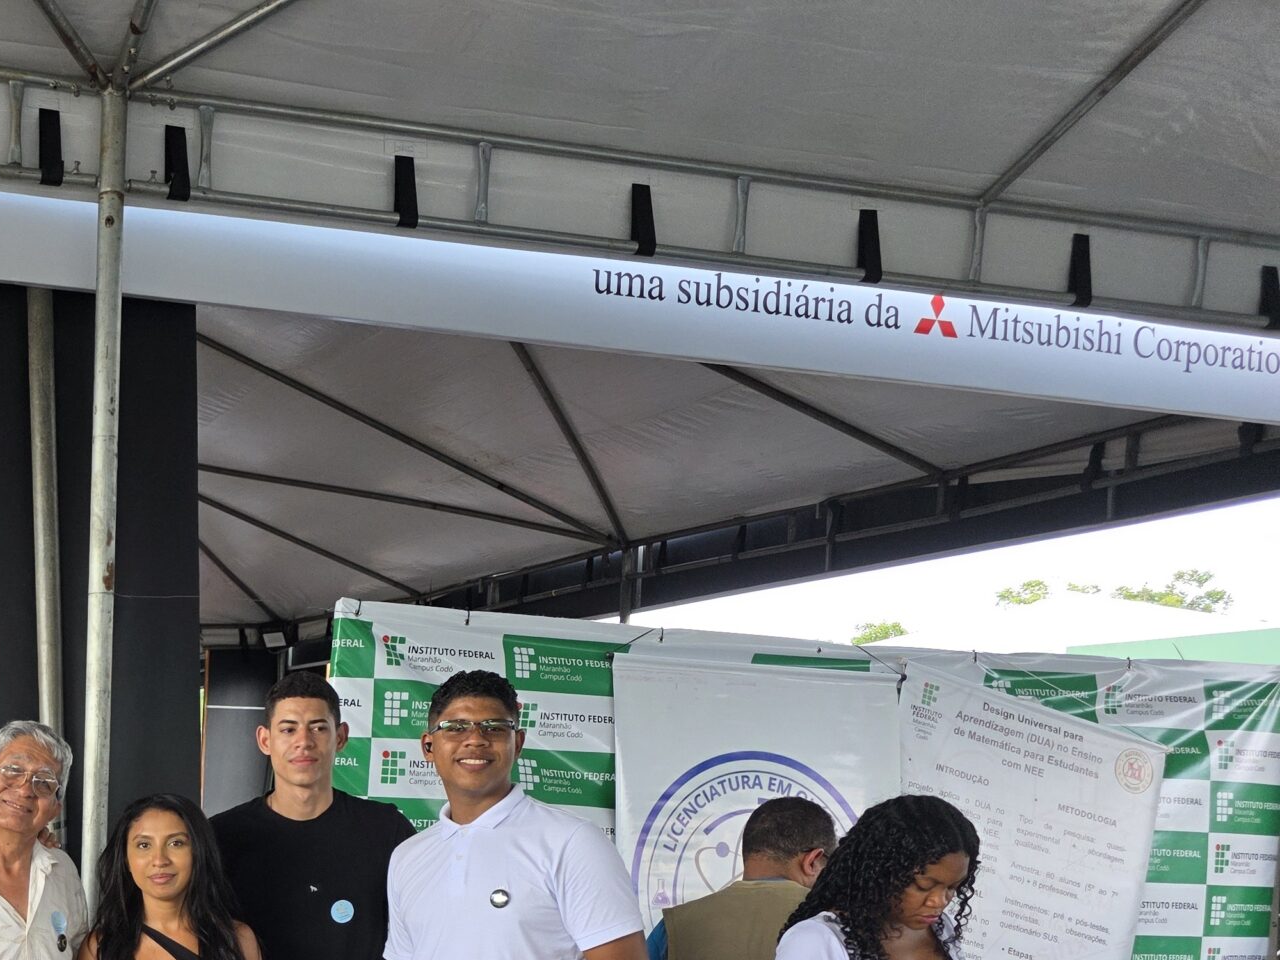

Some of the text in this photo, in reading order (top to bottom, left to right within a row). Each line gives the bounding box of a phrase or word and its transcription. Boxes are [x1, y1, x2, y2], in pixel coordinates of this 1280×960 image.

[593, 267, 666, 301] uma
[677, 273, 854, 327] subsidiária
[864, 292, 902, 330] da
[967, 304, 1123, 356] Mitsubishi
[407, 645, 496, 660] INSTITUTO FEDERAL
[407, 655, 442, 664] Maranhão
[539, 656, 612, 669] INSTITUTO FEDER
[408, 663, 454, 673] Campus Codó
[540, 665, 571, 674] Maranhão
[540, 673, 583, 682] Campus Codó
[1164, 695, 1198, 704] FEDERAL
[910, 703, 943, 719] INSTITUTO
[912, 710, 938, 724] FEDERAL
[540, 712, 615, 724] INSTITUTO FEDER
[982, 701, 1084, 743] Design Universal para
[539, 721, 572, 730] Maranhão
[538, 729, 583, 739] Campus Codó
[955, 710, 1103, 765] Aprendizagem (DUA) no Ensino
[954, 725, 966, 738] de
[968, 730, 1021, 756] Matemática
[1023, 749, 1044, 763] para
[1047, 755, 1099, 780] Estudantes
[540, 768, 582, 780] INSTITUTO
[1001, 758, 1045, 778] com NEE
[935, 763, 990, 787] INTRODUÇÃO
[409, 778, 437, 787] Campus
[543, 785, 583, 795] Campus Codó
[908, 780, 934, 794] projeto
[975, 799, 992, 811] DUA
[995, 807, 1005, 816] no
[663, 774, 793, 853] LICENCIATURA EM
[1019, 814, 1034, 825] Tipo
[1057, 803, 1118, 828] METODOLOGIA
[987, 816, 1003, 828] para
[1172, 850, 1201, 858] FEDERAL
[1171, 902, 1199, 910] FEDERAL
[1053, 911, 1065, 921] pré
